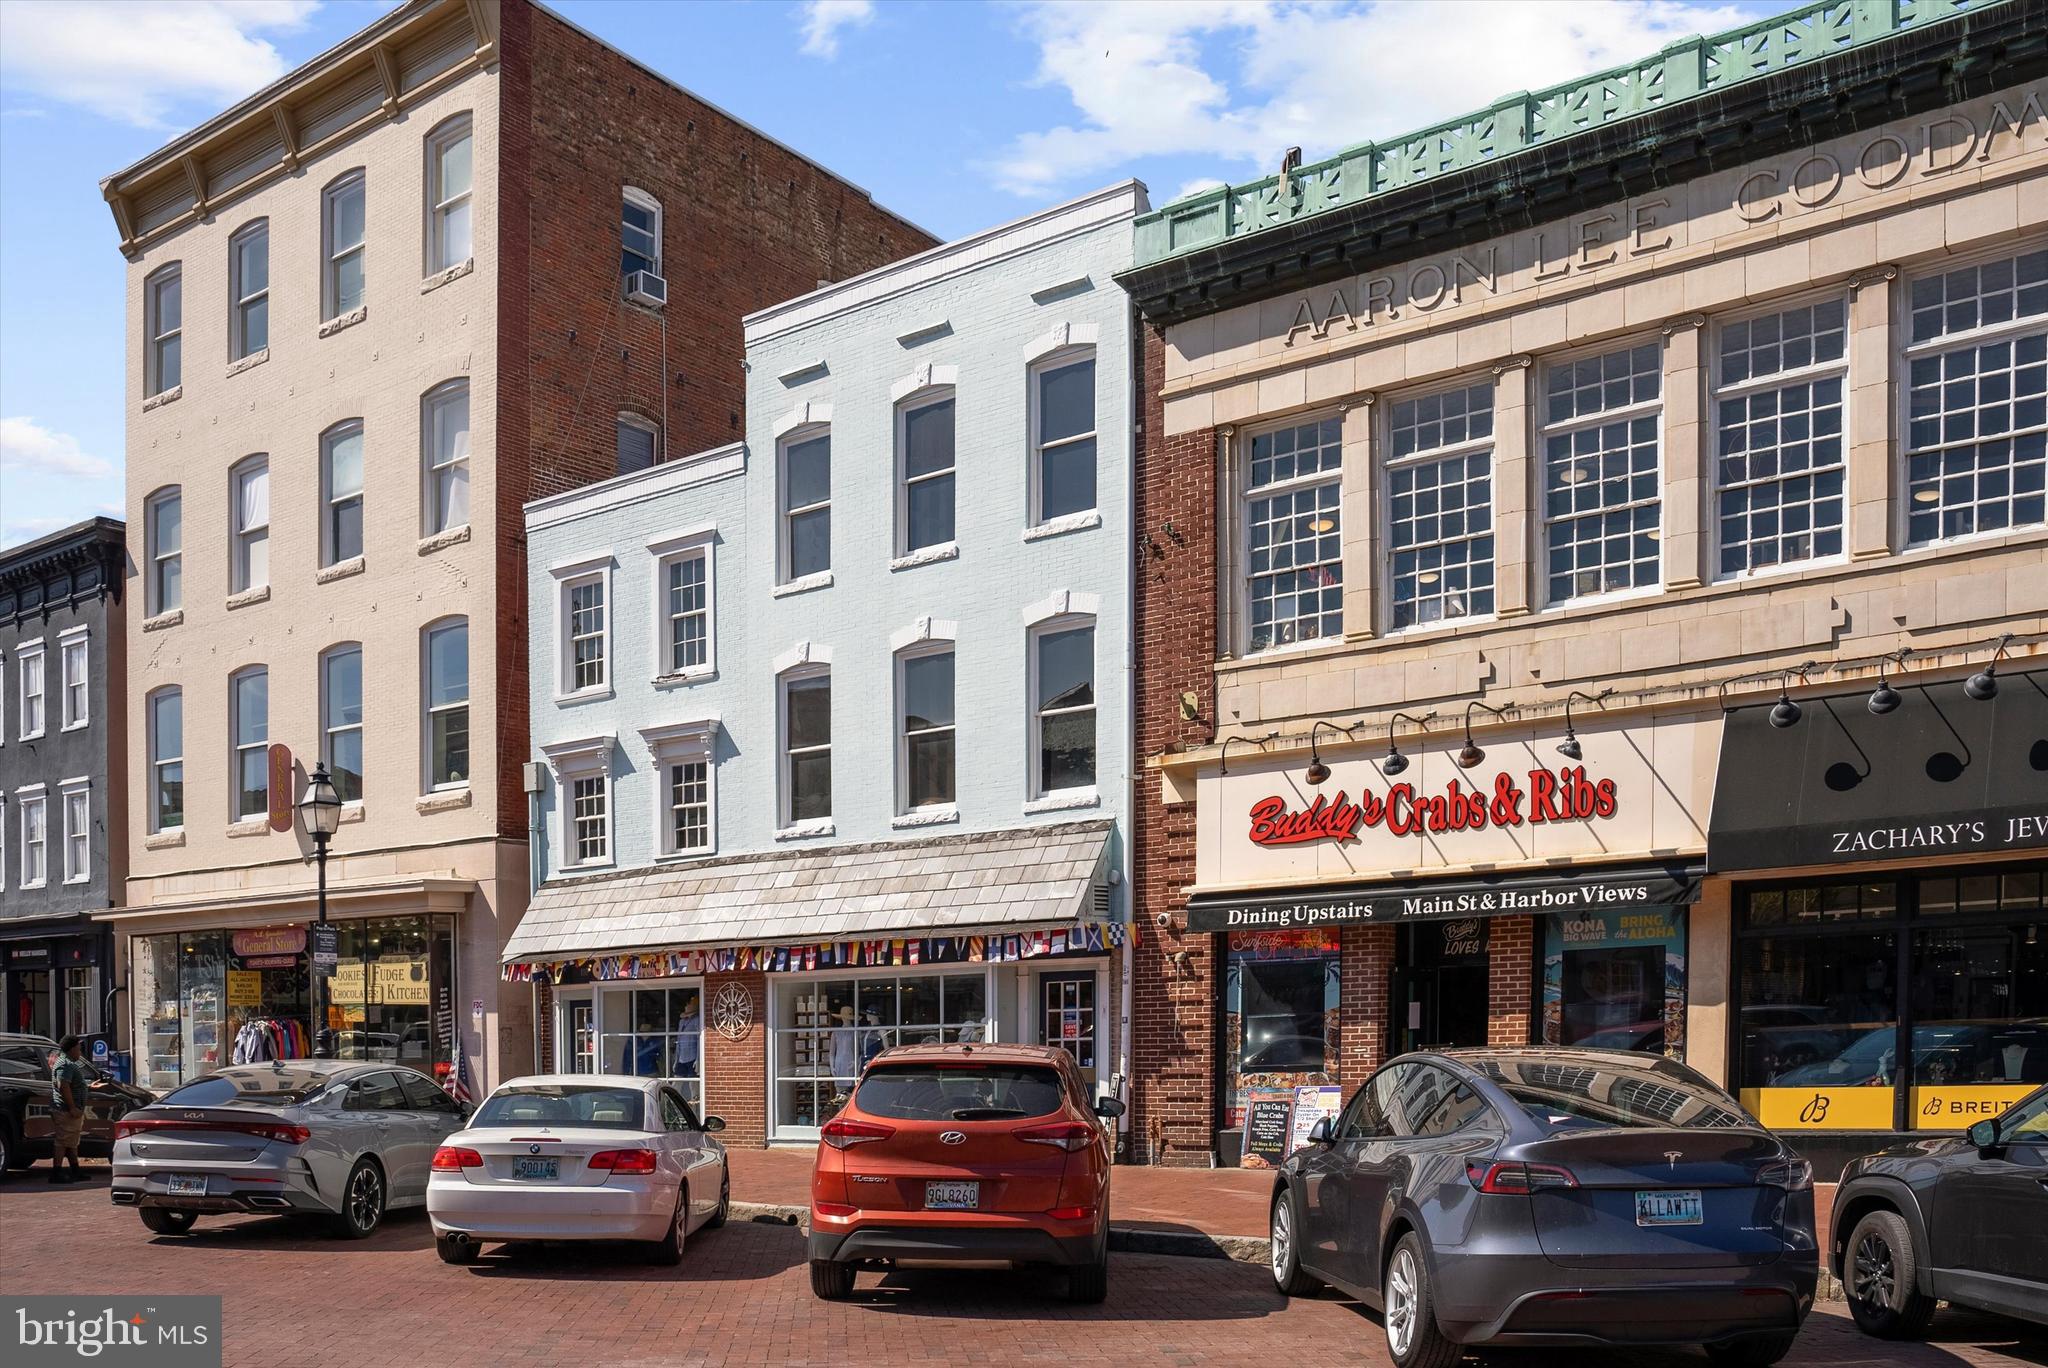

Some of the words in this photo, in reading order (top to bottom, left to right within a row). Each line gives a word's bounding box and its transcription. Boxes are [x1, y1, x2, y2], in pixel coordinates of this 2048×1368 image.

[1284, 246, 1497, 347] AARON
[1532, 198, 1673, 283] LEE
[1250, 789, 1386, 845] Buddy's
[1385, 779, 1486, 836] Crabs
[1490, 772, 1521, 826] &
[1528, 765, 1615, 823] Ribs
[1832, 821, 1985, 853] ZACHARY'S
[1227, 907, 1291, 925] Dining
[1293, 902, 1373, 925] Upstairs
[1402, 897, 1454, 915] Main
[1456, 895, 1478, 911] St
[1480, 892, 1497, 910] &
[1499, 889, 1577, 909] Harbor
[1579, 886, 1648, 903] Views
[1563, 919, 1606, 933] KONA
[1620, 915, 1664, 928] BRING
[1563, 932, 1580, 941] BIG
[1580, 930, 1607, 940] WAVE
[1614, 929, 1627, 939] the
[1628, 926, 1676, 939] ALOHA
[1444, 940, 1480, 955] LOVES
[374, 966, 405, 981] FUDGE
[387, 984, 429, 1000] KITCHEN
[96, 1044, 103, 1053] P
[1272, 1103, 1281, 1111] Can
[928, 1189, 976, 1203] 9GL8260
[1640, 1199, 1698, 1216] KLLAWTT
